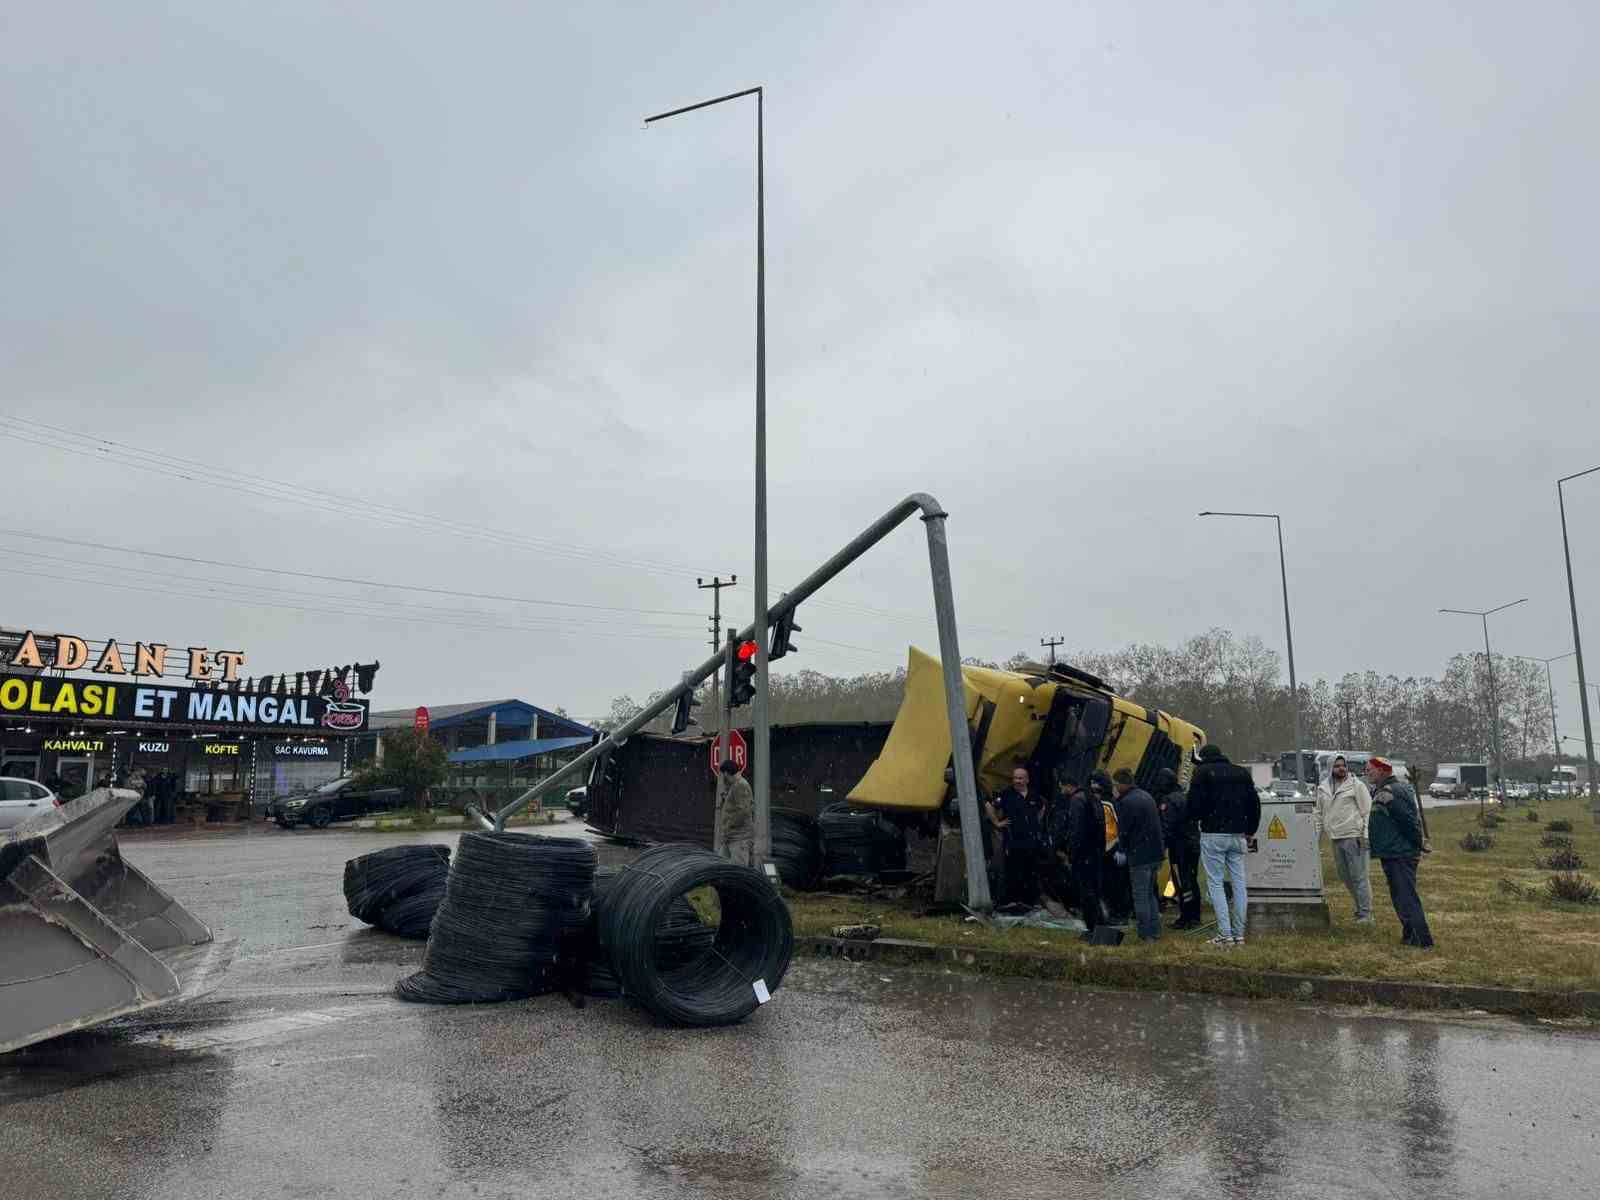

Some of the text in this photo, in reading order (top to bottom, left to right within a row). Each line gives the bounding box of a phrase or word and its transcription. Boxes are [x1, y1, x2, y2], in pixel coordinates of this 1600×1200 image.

[9, 630, 244, 682] ADAN ET
[0, 679, 315, 725] OLASI ET MANGAL
[44, 740, 104, 751] KAHVALTI
[139, 743, 170, 752] KUZU
[205, 744, 239, 754] KÖFTE
[293, 747, 329, 755] KAVURMA
